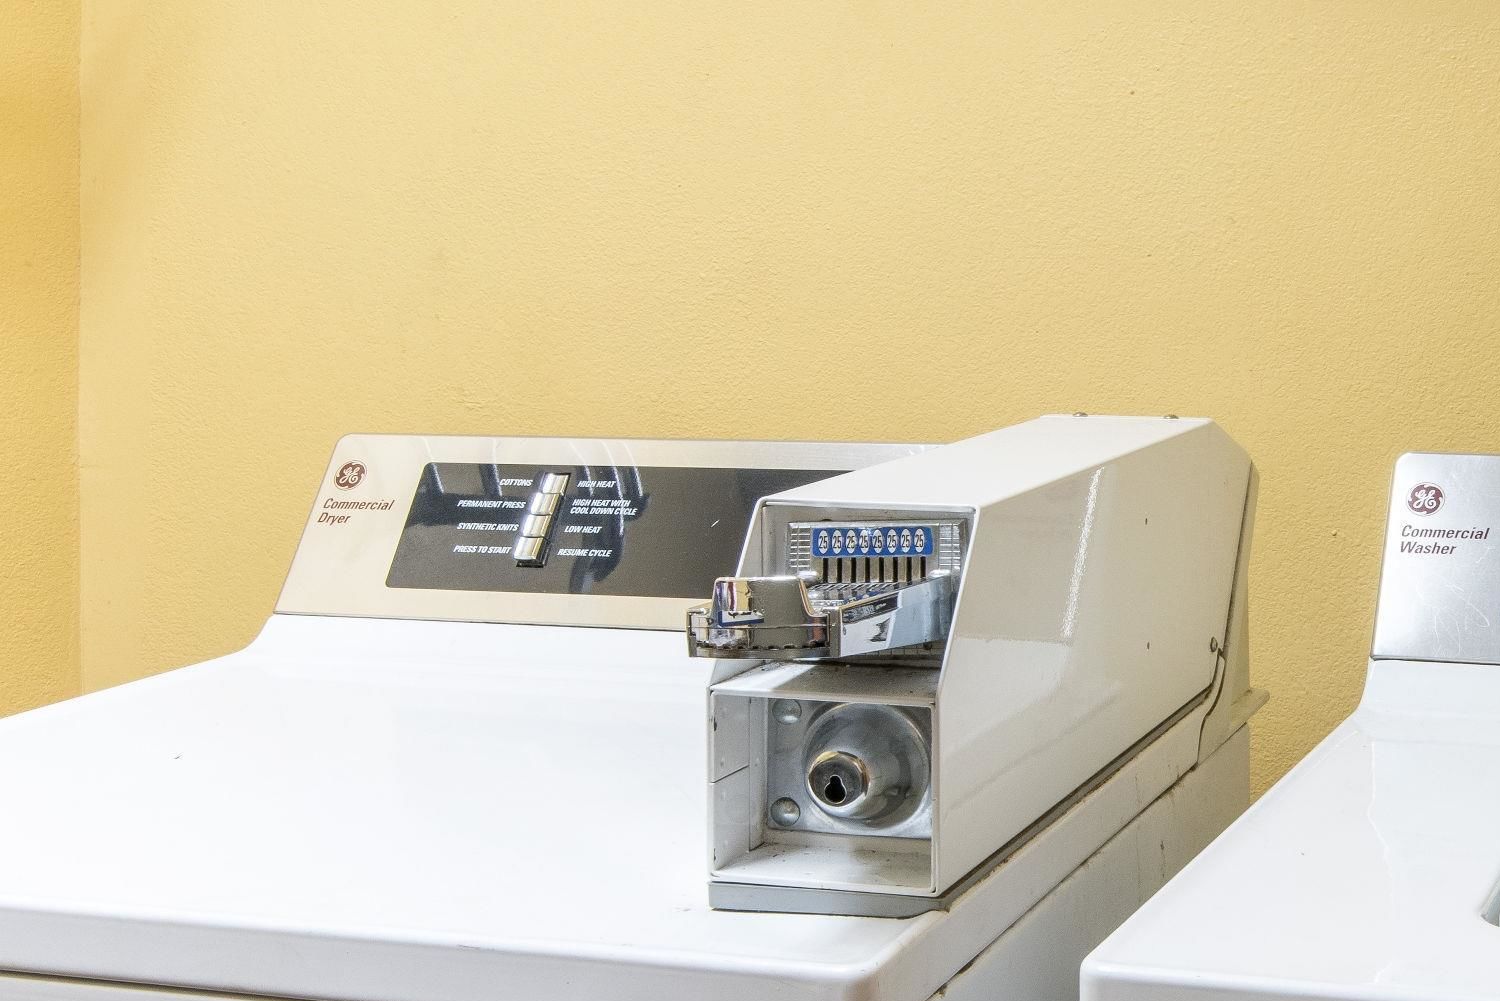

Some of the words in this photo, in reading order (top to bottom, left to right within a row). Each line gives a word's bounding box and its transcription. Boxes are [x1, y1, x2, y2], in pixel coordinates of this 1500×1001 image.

[500, 479, 533, 487] COTTONS
[324, 498, 395, 511] Commercial
[457, 500, 503, 508] PERMANENT
[502, 501, 526, 509] PRESS
[590, 507, 613, 515] DOWN
[318, 512, 351, 526] Dryer
[582, 526, 602, 534] HEAT
[1402, 525, 1490, 539] Commercial
[819, 536, 828, 548] 25
[833, 536, 842, 548] 25
[847, 535, 855, 548] 25
[860, 535, 868, 548] 25
[873, 535, 882, 548] 25
[888, 535, 896, 548] 25
[902, 535, 910, 548] 25
[915, 534, 924, 548] 25
[454, 545, 478, 553] PRESS
[557, 548, 588, 556] RESUME
[589, 549, 612, 557] CYCLE
[1400, 541, 1456, 555] Washer
